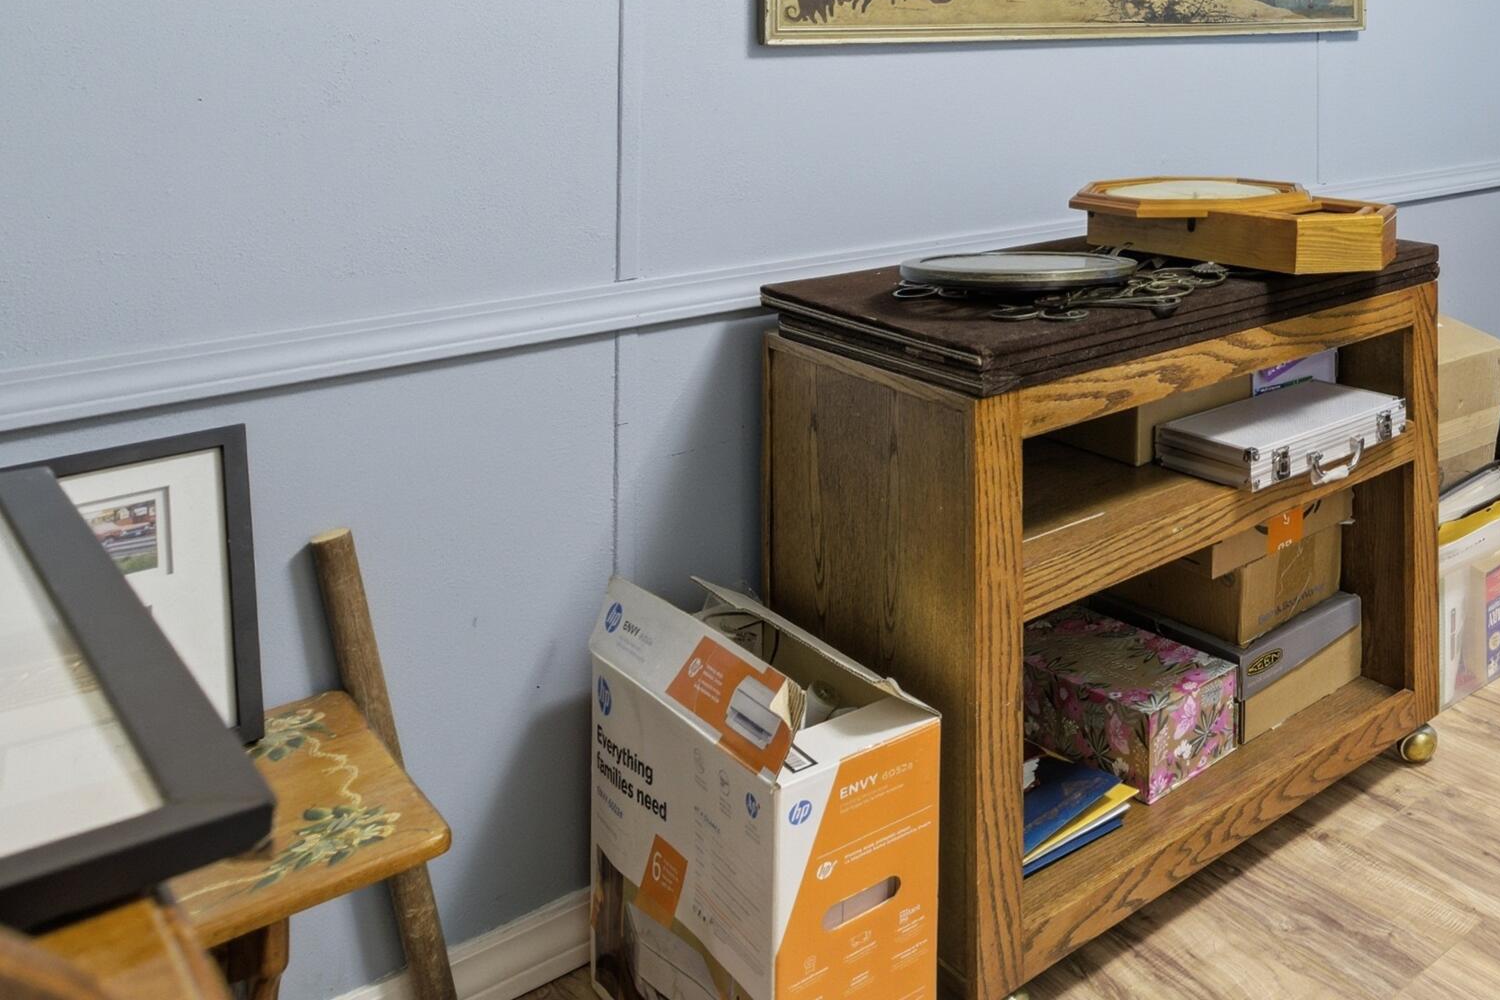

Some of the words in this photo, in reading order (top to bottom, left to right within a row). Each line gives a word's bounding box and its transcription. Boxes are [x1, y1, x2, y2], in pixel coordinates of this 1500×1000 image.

[623, 620, 641, 637] ENVY
[1248, 649, 1281, 673] KEEN
[597, 723, 654, 785] Everything
[597, 751, 634, 799] families
[637, 788, 667, 822] need
[840, 773, 879, 800] ENVY
[788, 800, 812, 825] hp
[652, 850, 663, 881] 6
